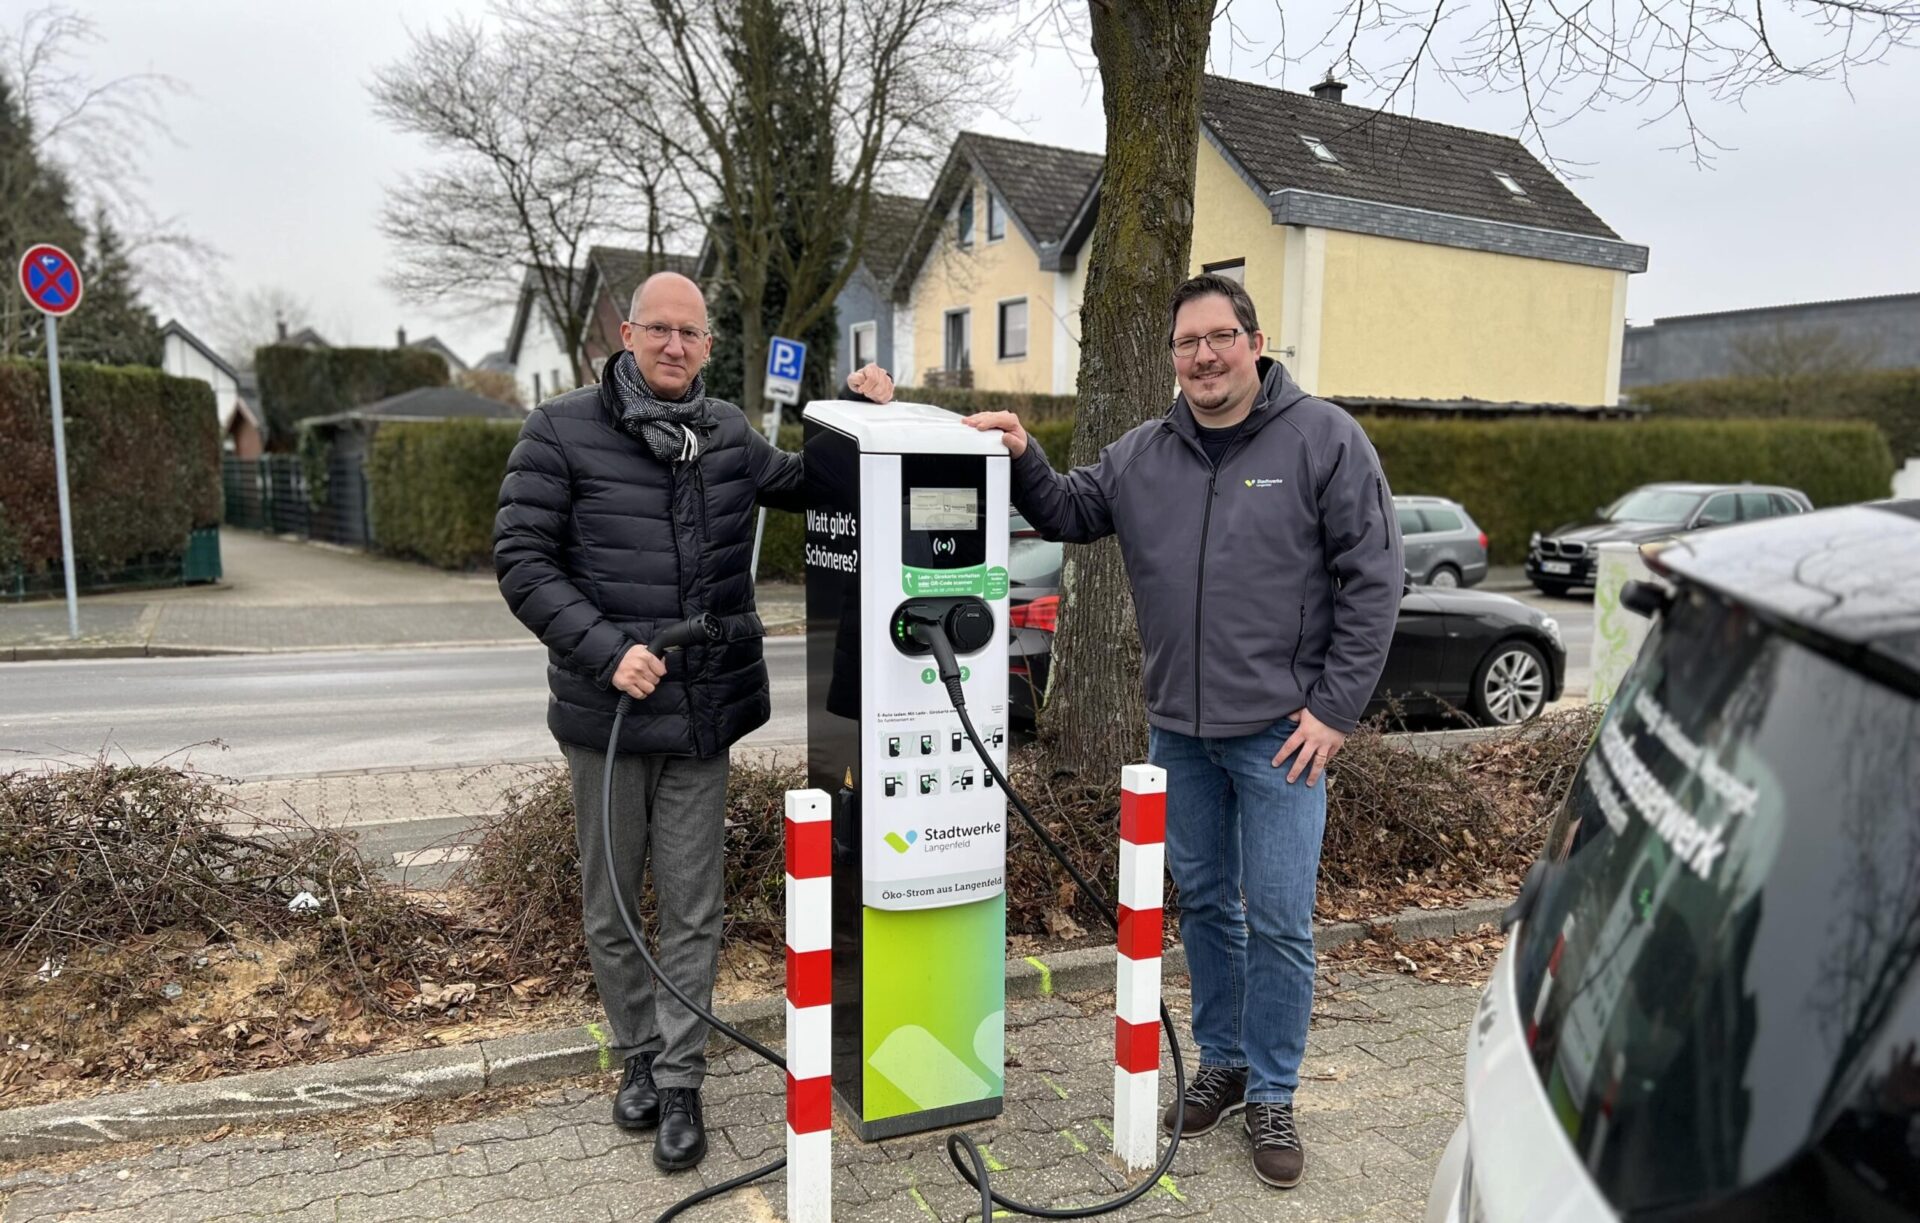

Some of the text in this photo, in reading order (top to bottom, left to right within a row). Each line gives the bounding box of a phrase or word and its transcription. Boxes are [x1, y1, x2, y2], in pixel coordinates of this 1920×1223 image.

[773, 343, 795, 373] P
[806, 508, 856, 540] Watt gibt's
[806, 543, 858, 573] Schöneres?
[926, 671, 932, 680] 1
[925, 822, 1001, 841] Stadtwerke
[924, 840, 970, 853] Langenfeld
[882, 876, 1002, 900] Öko-Strom aus Langenfeld
